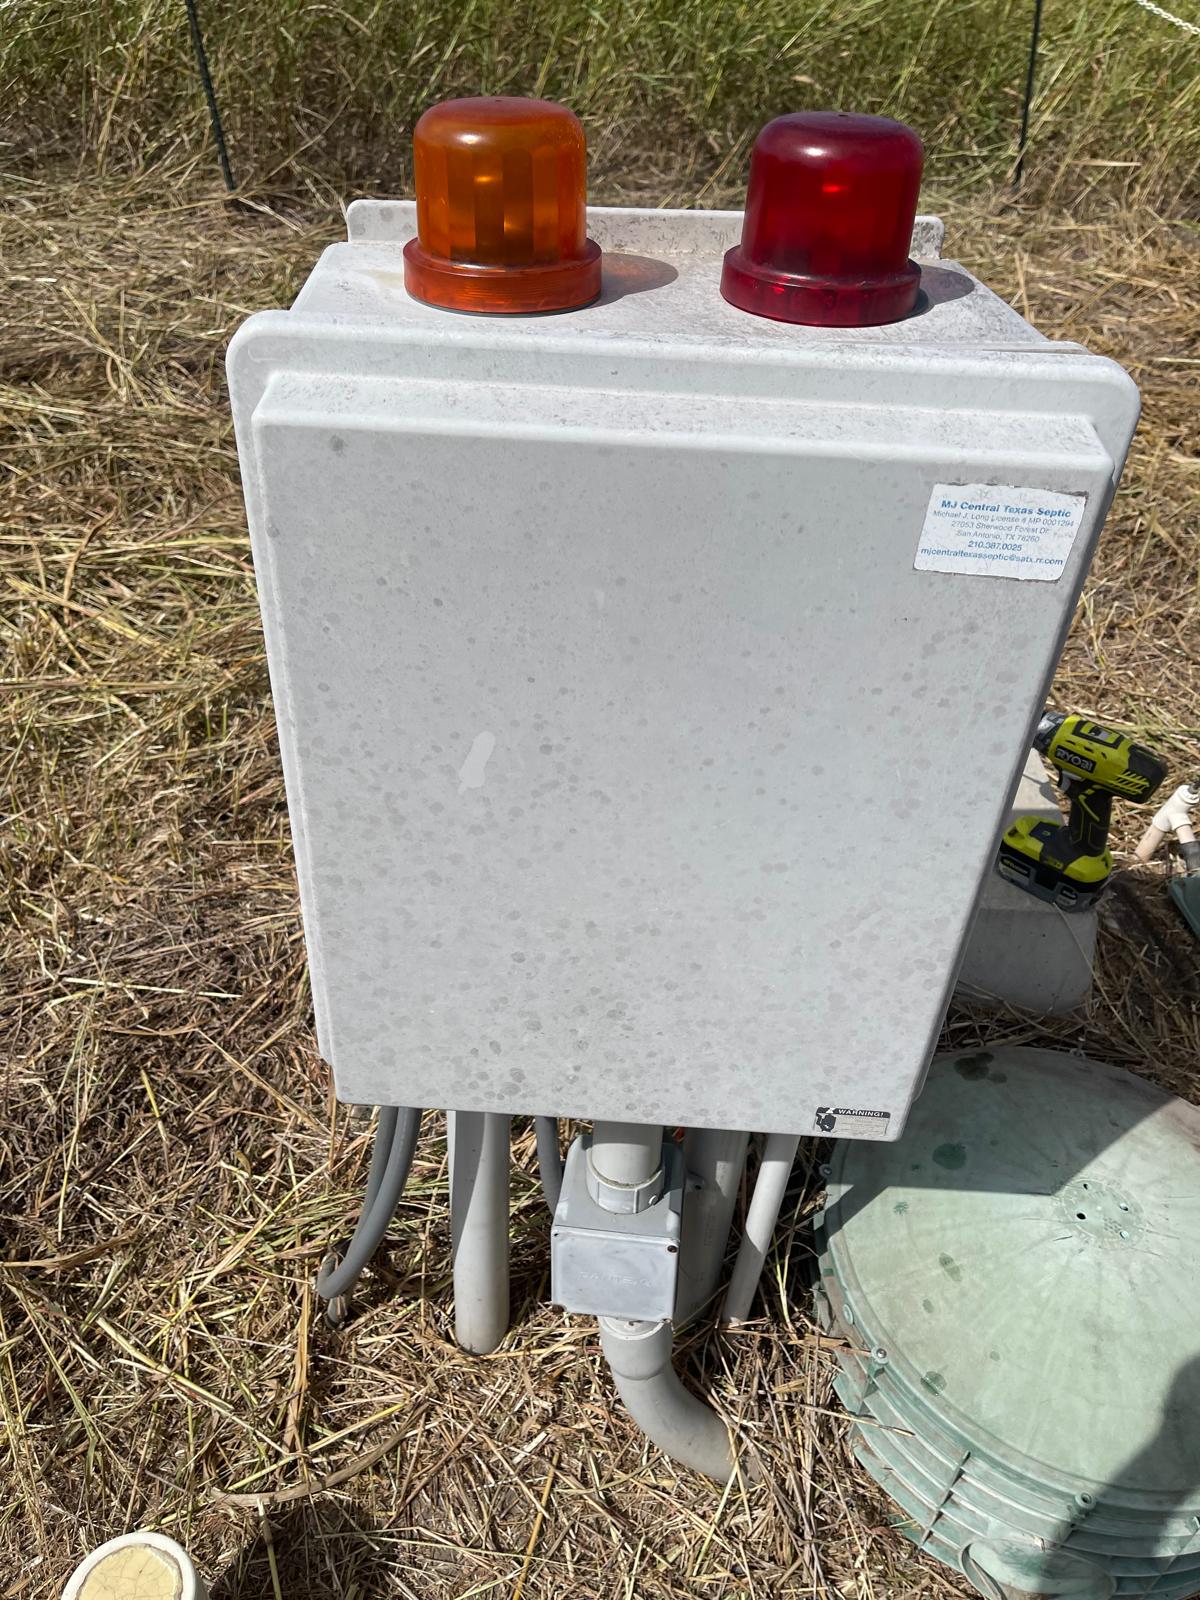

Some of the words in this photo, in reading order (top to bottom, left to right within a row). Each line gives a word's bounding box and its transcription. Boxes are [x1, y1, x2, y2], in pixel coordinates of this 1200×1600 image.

[941, 500, 957, 509] MJ
[960, 501, 1000, 513] Central
[1004, 504, 1033, 515] Texas
[1036, 507, 1071, 518] Septic
[932, 510, 961, 518] Michael
[971, 513, 989, 522] Long
[990, 515, 1020, 523] License
[1027, 517, 1041, 525] MP
[975, 522, 1013, 531] Sherwood
[1014, 525, 1038, 533] Forest
[956, 529, 971, 537] San
[971, 531, 1002, 540] Antonio,
[968, 540, 1023, 552] 210.387.0025
[1055, 748, 1093, 772] RYOBI
[838, 1109, 884, 1117] WARNING!
